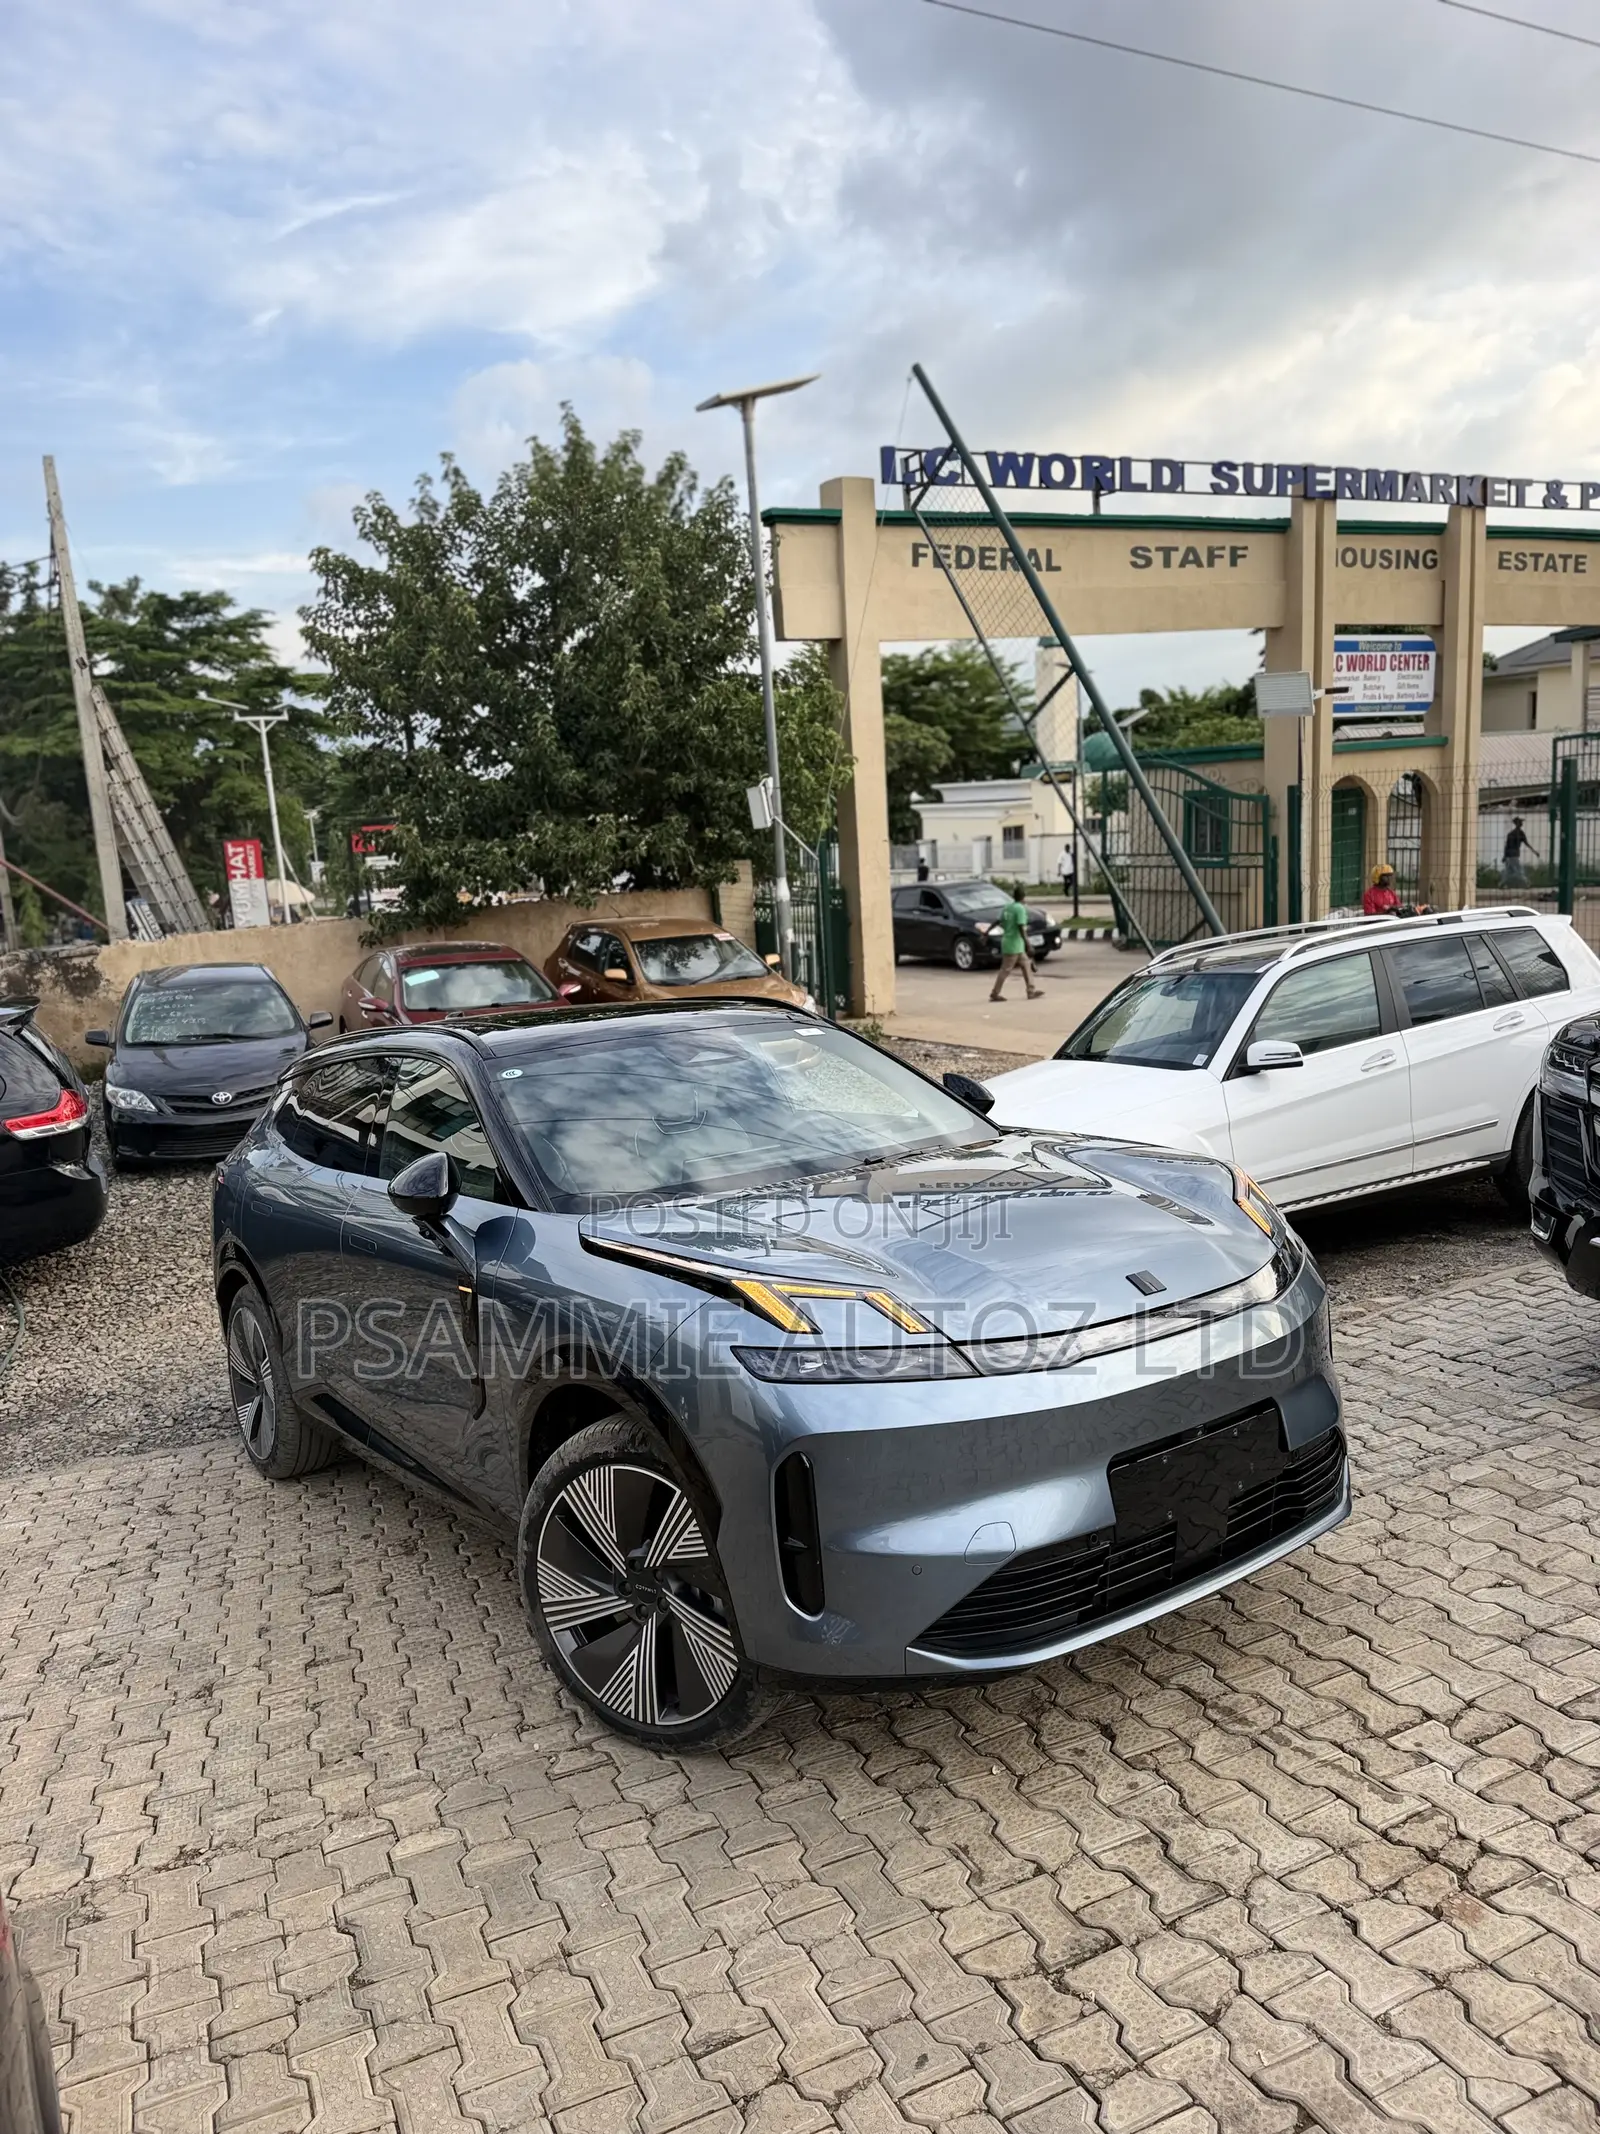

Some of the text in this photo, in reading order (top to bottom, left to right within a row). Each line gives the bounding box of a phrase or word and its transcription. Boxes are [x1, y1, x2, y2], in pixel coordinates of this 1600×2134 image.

[985, 451, 1184, 493] WORLD
[1210, 461, 1533, 508] SUPERMARKET
[1542, 479, 1569, 509] &
[911, 543, 1588, 573] FEDERAL STAFF OUSING ESTATE
[1346, 654, 1387, 672] WORLD
[1389, 653, 1430, 672] CENTER
